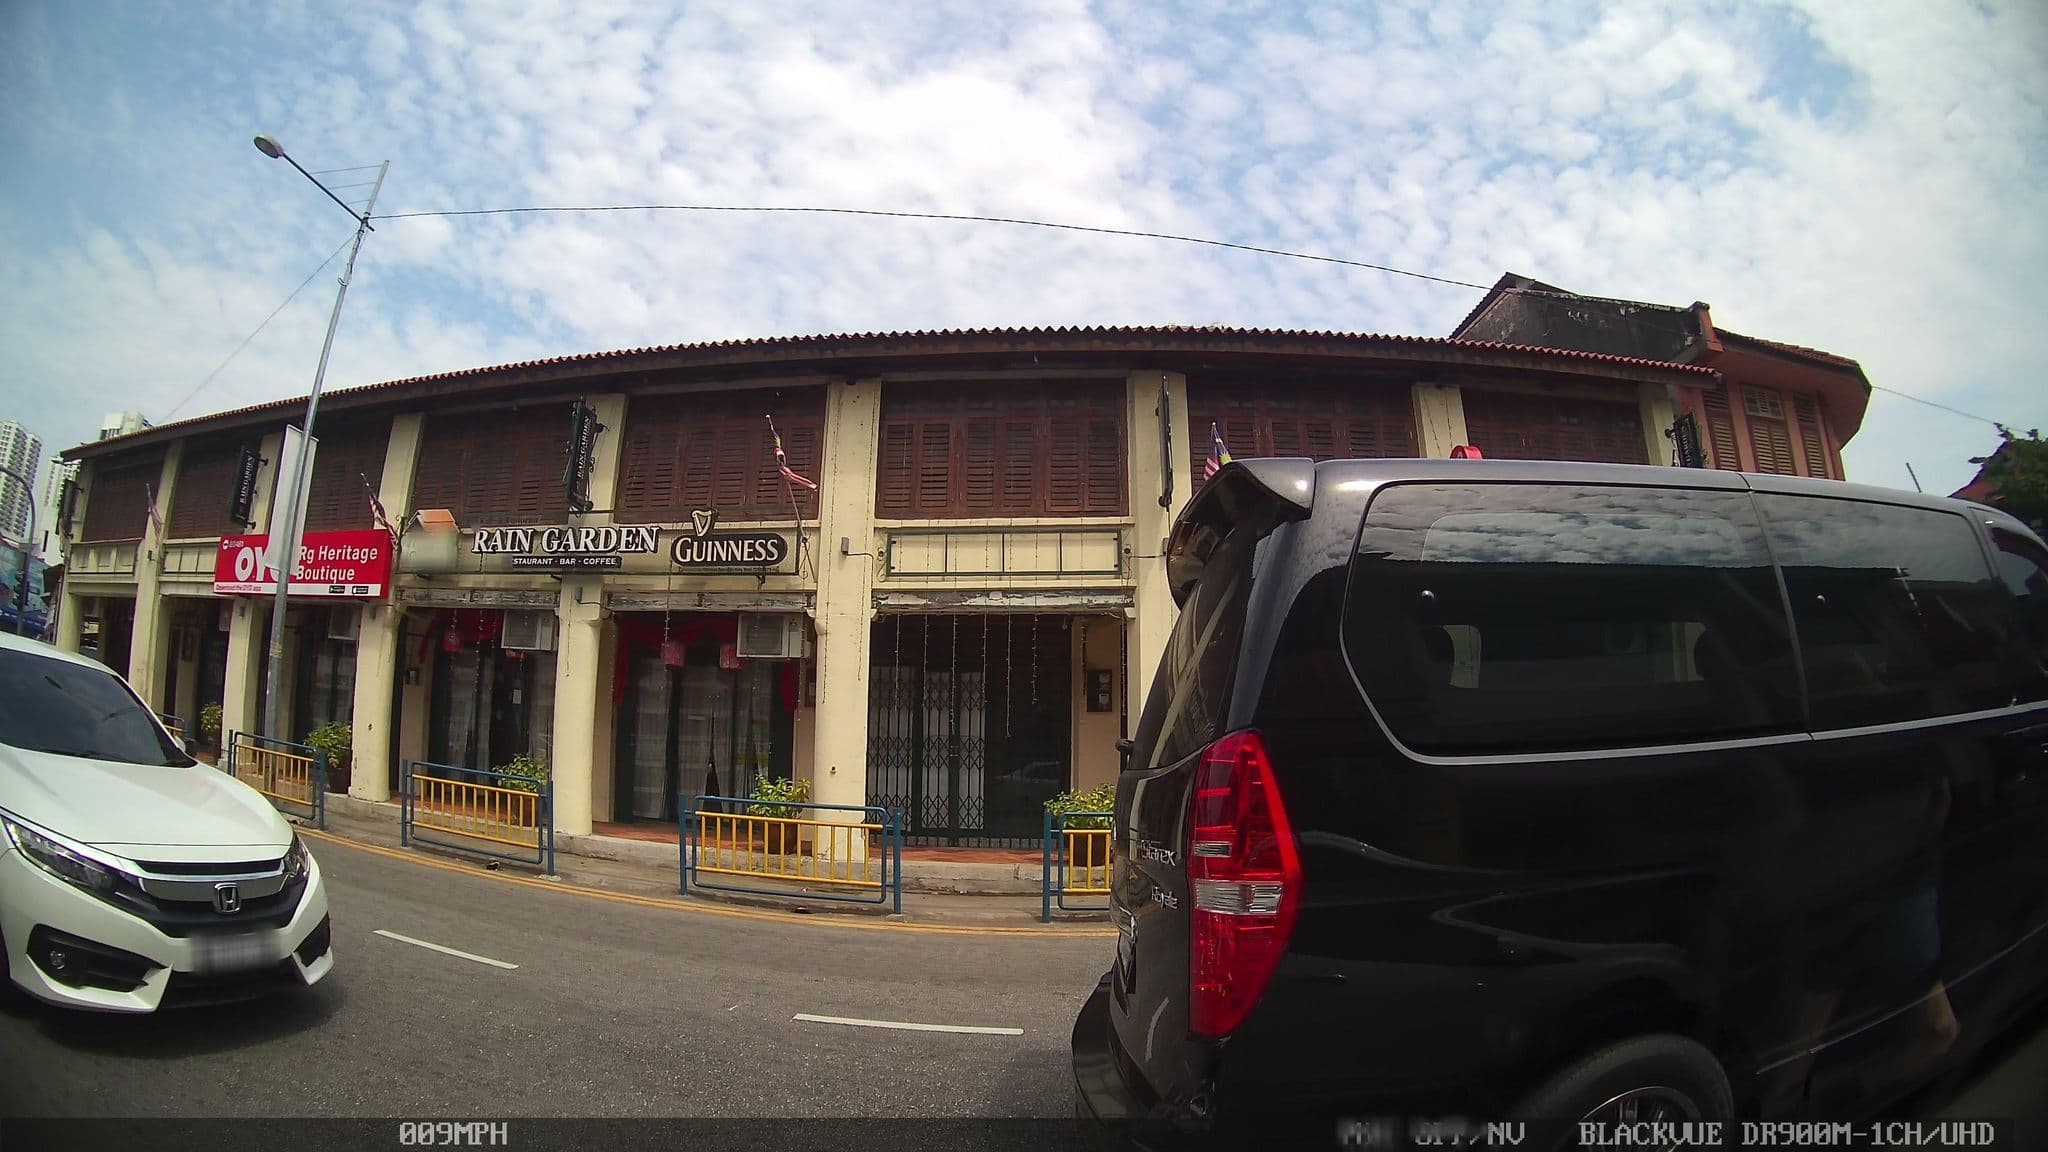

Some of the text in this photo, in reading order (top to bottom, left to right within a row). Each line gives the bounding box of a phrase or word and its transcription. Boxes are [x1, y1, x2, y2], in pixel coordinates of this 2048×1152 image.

[472, 526, 660, 554] RAIN GARDEN
[675, 537, 779, 563] GUINNESS
[235, 546, 280, 582] OY
[318, 545, 378, 564] Heritage
[559, 557, 577, 566] BAR
[583, 556, 617, 566] COFFEE
[296, 566, 355, 583] Boutique
